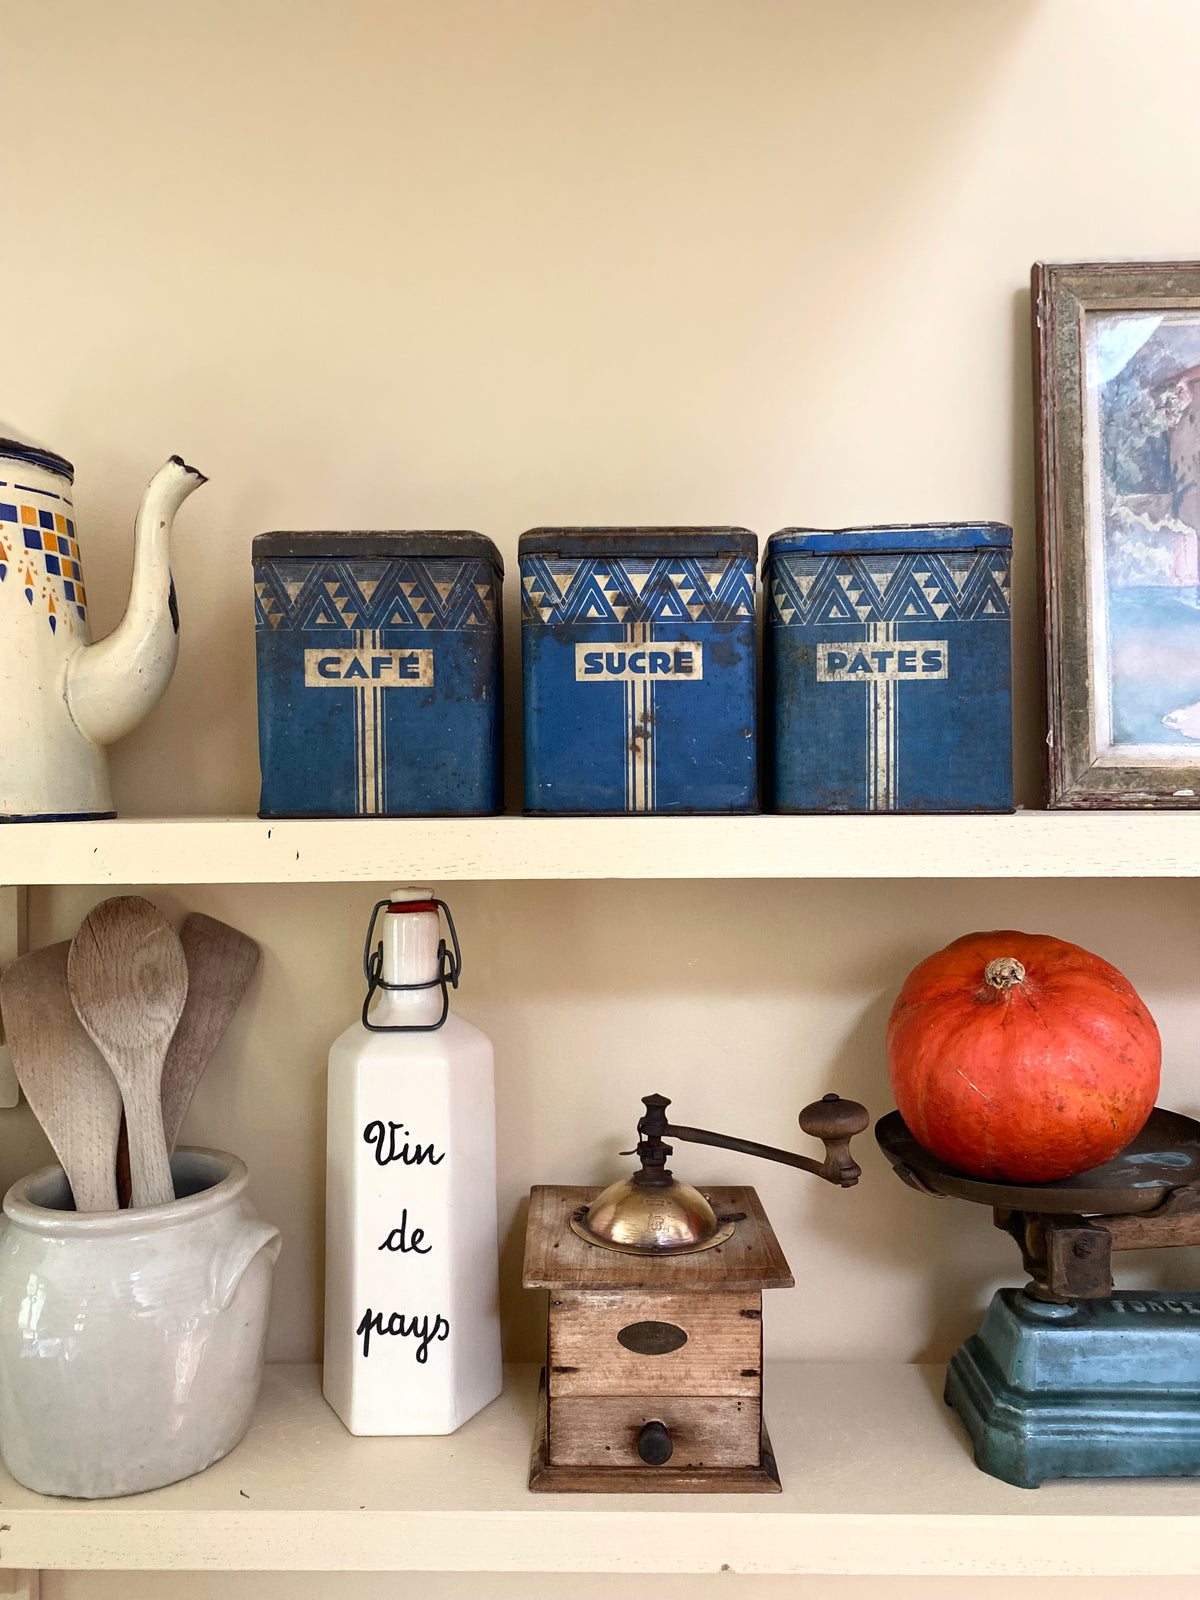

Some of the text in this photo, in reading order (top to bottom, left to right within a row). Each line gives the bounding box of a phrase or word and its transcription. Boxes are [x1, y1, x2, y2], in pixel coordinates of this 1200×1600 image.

[317, 651, 420, 679] CAFÉ
[583, 651, 693, 675] SUCRE
[363, 1120, 446, 1166] Vin
[377, 1208, 433, 1255] de
[356, 1308, 450, 1364] pays
